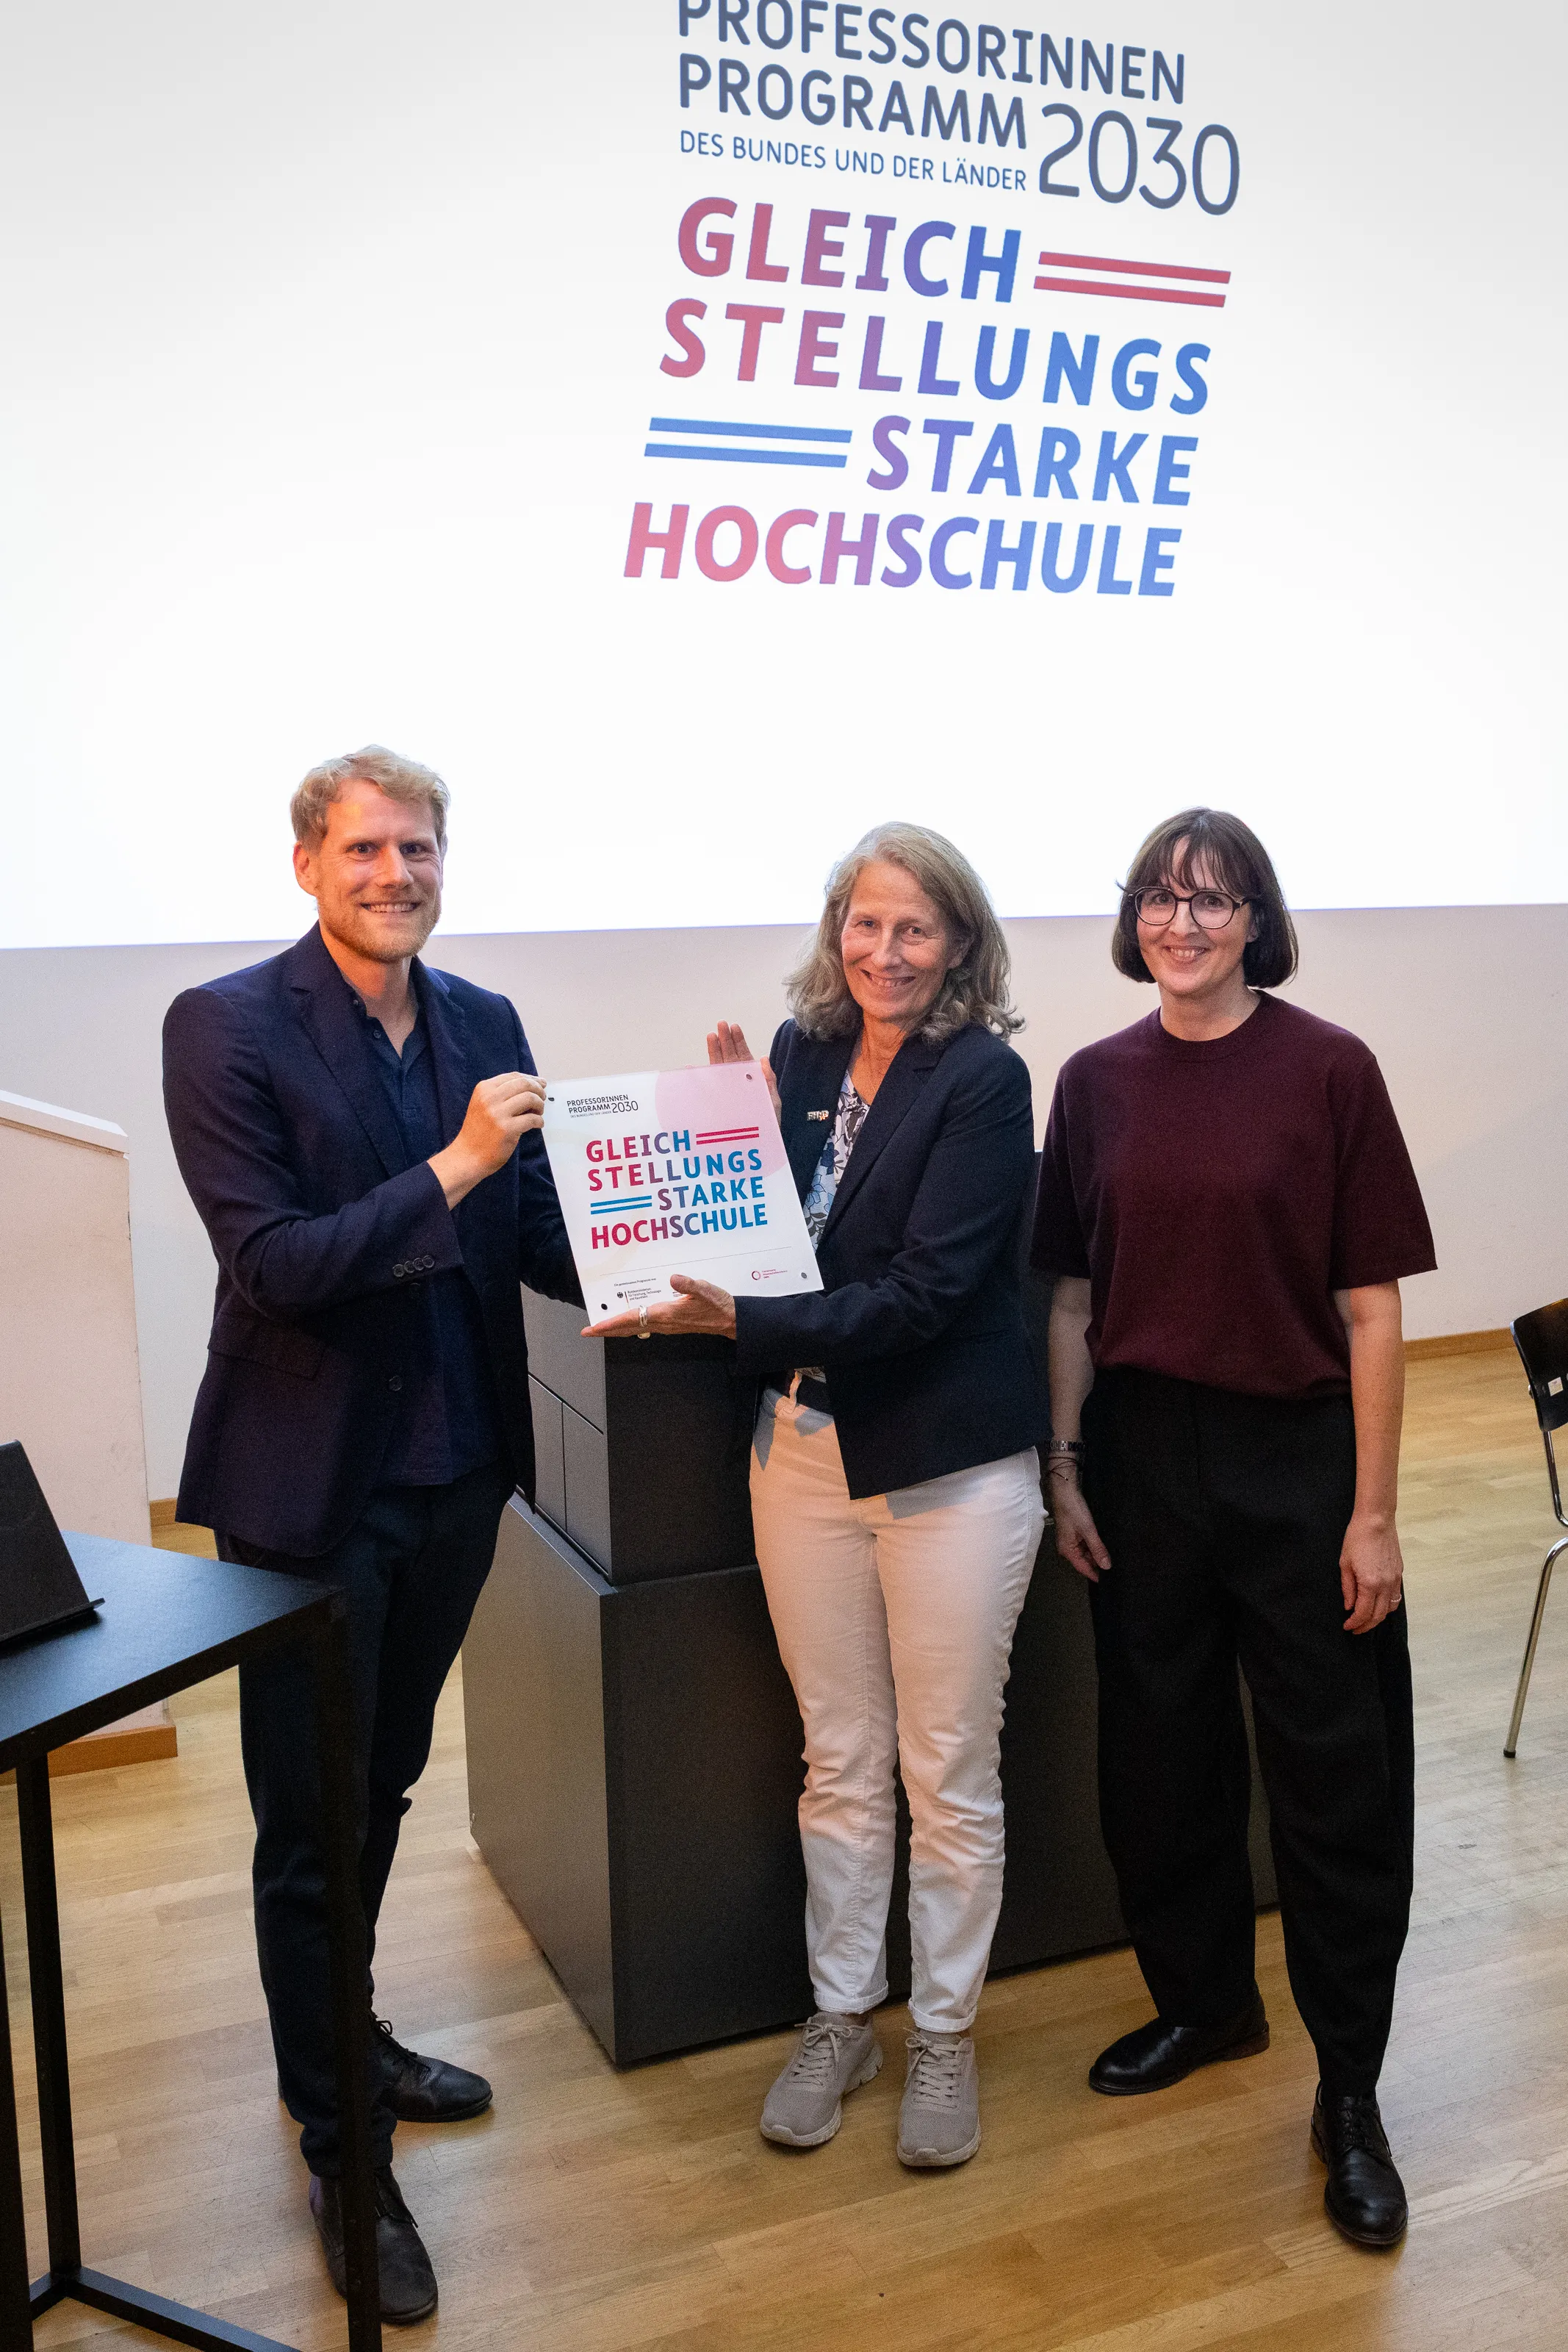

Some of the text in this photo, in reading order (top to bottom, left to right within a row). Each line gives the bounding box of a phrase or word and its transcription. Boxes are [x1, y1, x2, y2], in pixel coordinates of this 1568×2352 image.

[678, 0, 1186, 104] PROFESSORINNEN
[678, 52, 1241, 216] PROGRAMM 2030
[680, 129, 1027, 192] DES BUNDES UND DER LÄNDER
[677, 196, 1022, 304] GLEICH
[658, 297, 1212, 416] STELLUNGS
[866, 414, 1200, 507] STARKE
[622, 501, 1183, 598] HOCHSCHULE
[567, 1094, 629, 1107] PROFESSORINNEN
[568, 1100, 639, 1114] PROGRAMM 2030
[586, 1129, 691, 1163] GLEICH
[587, 1148, 763, 1191] STELLUNGS
[657, 1175, 766, 1211] STARKE
[591, 1203, 768, 1250] HOCHSCHULE
